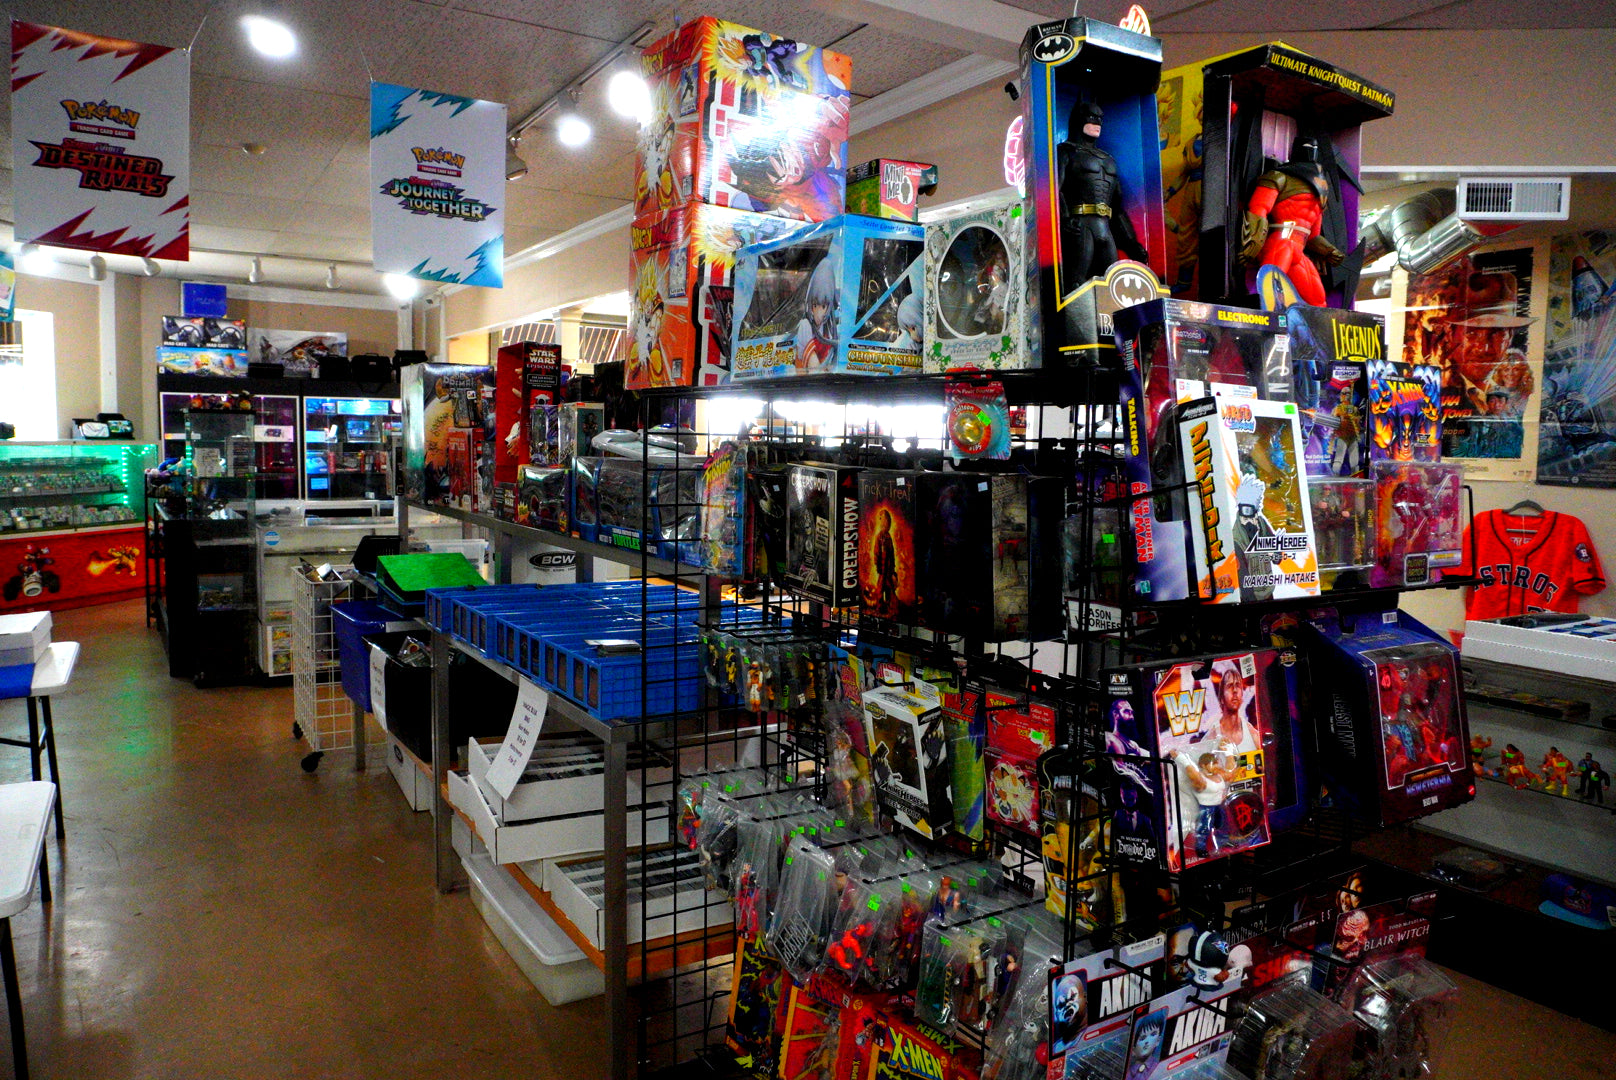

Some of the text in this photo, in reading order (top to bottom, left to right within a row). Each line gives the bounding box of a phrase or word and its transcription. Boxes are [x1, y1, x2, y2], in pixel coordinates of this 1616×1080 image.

[1271, 53, 1393, 107] ULTIMATE KNIGHTQUEST BATMAN
[76, 124, 129, 137] TRADING CARD GAME
[44, 148, 158, 175] DESTINED
[85, 169, 164, 193] RIVALS
[390, 179, 456, 200] JOURNEY
[407, 198, 483, 219] TOGETHER
[1217, 310, 1270, 326] ELECTRONIC
[1332, 318, 1381, 360] LEGENDS
[530, 350, 556, 358] STAR
[530, 356, 556, 364] WARS
[1386, 380, 1426, 404] X-MEN
[1127, 397, 1139, 457] TALKING
[1141, 482, 1154, 560] ATER BURNER
[612, 534, 641, 551] TURTLES
[842, 496, 859, 589] CREEPSHOW
[541, 555, 575, 565] BCW
[1243, 572, 1316, 588] KAKASHI HATAKE
[1075, 615, 1122, 630] VORHEES
[1089, 608, 1112, 621] ASON
[1142, 842, 1157, 861] Lee
[1363, 924, 1430, 951] BLAIR WITCH
[1100, 967, 1152, 1019] AKIRA
[1169, 997, 1229, 1055] AKIRA
[916, 1023, 965, 1056] X-MEN
[888, 1025, 945, 1080] X-MEN
